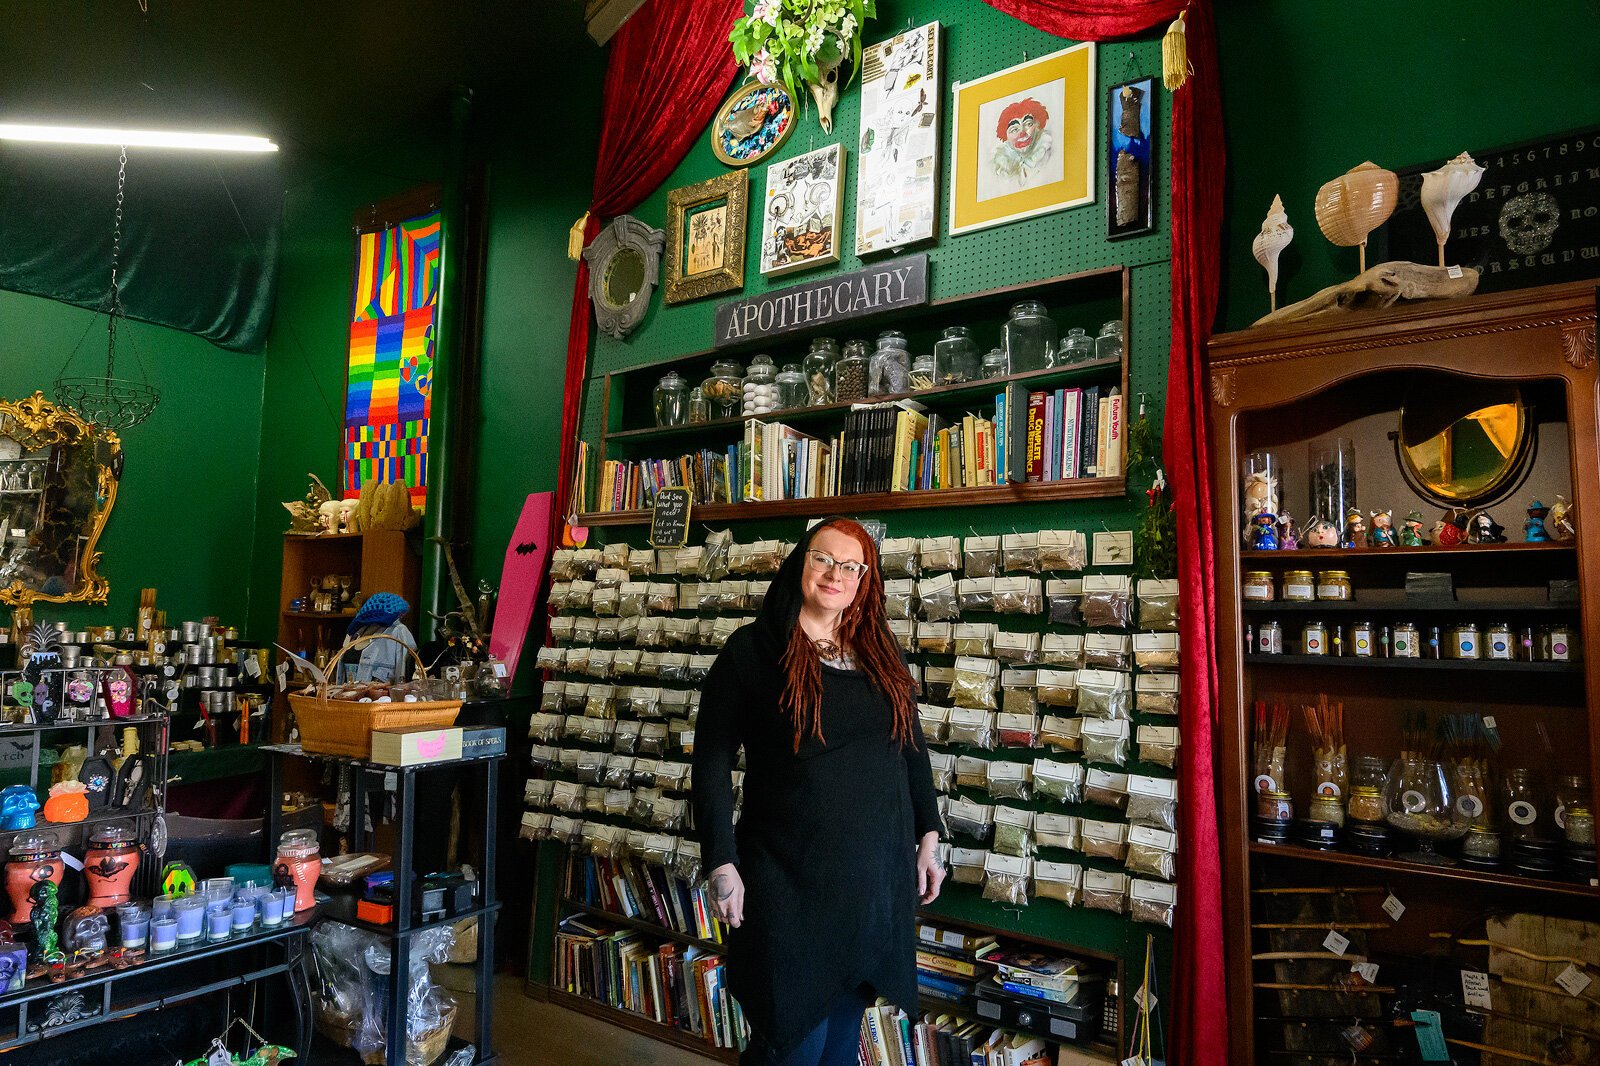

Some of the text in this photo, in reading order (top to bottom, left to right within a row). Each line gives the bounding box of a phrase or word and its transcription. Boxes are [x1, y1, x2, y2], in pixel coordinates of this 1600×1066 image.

[1513, 154, 1519, 164] 5
[1527, 151, 1536, 161] 6
[1543, 147, 1551, 158] 7
[1560, 144, 1567, 155] 8
[1576, 140, 1585, 151] 9
[725, 266, 912, 340] APOTHECARY
[1026, 408, 1036, 472] DRUG REFERENCE
[1034, 418, 1043, 460] COMPLETE
[0, 751, 24, 760] tch
